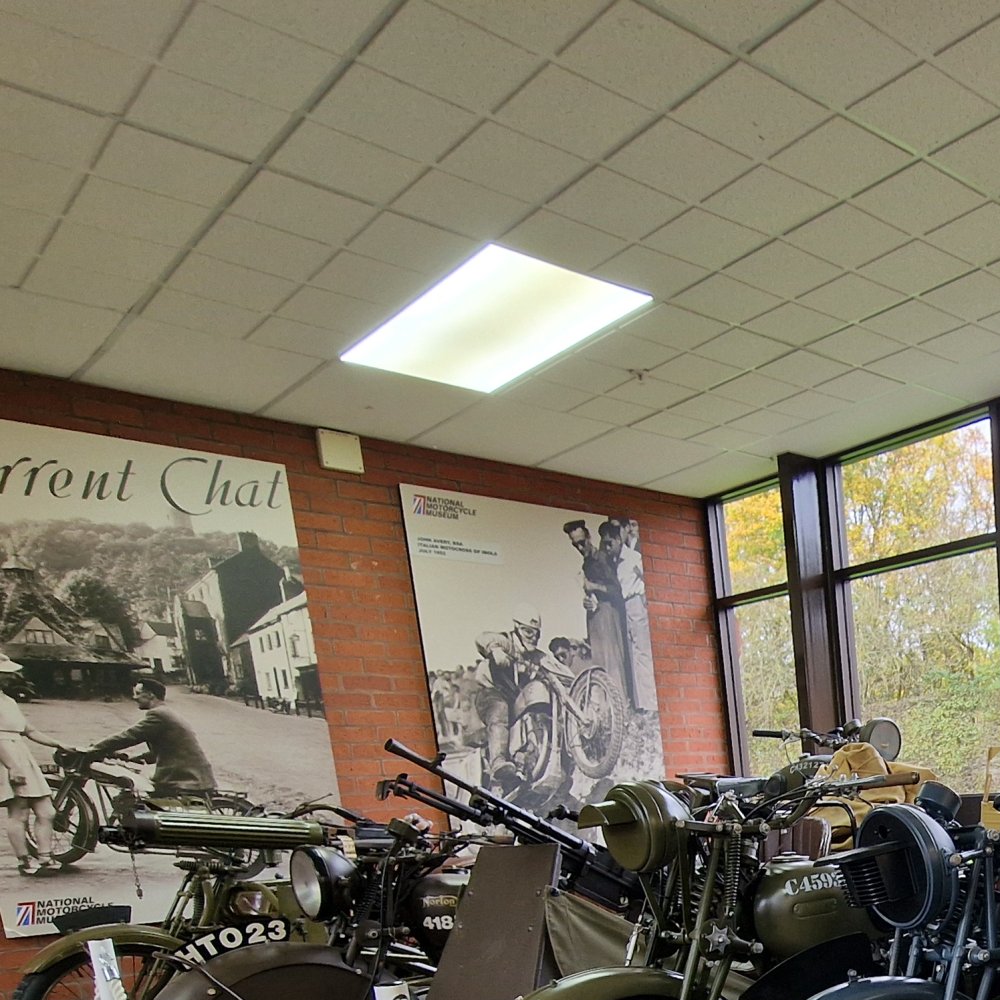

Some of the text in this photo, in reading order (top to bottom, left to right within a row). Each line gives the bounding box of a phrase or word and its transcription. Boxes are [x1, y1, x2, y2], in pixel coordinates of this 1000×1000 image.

[160, 456, 284, 516] Chat
[426, 496, 464, 508] NATIONAL
[425, 510, 459, 520] MUSEUM
[426, 503, 477, 516] MOTORCYCLE
[37, 897, 95, 909] NATIONAL
[421, 895, 458, 908] Norton
[423, 915, 456, 930] 418
